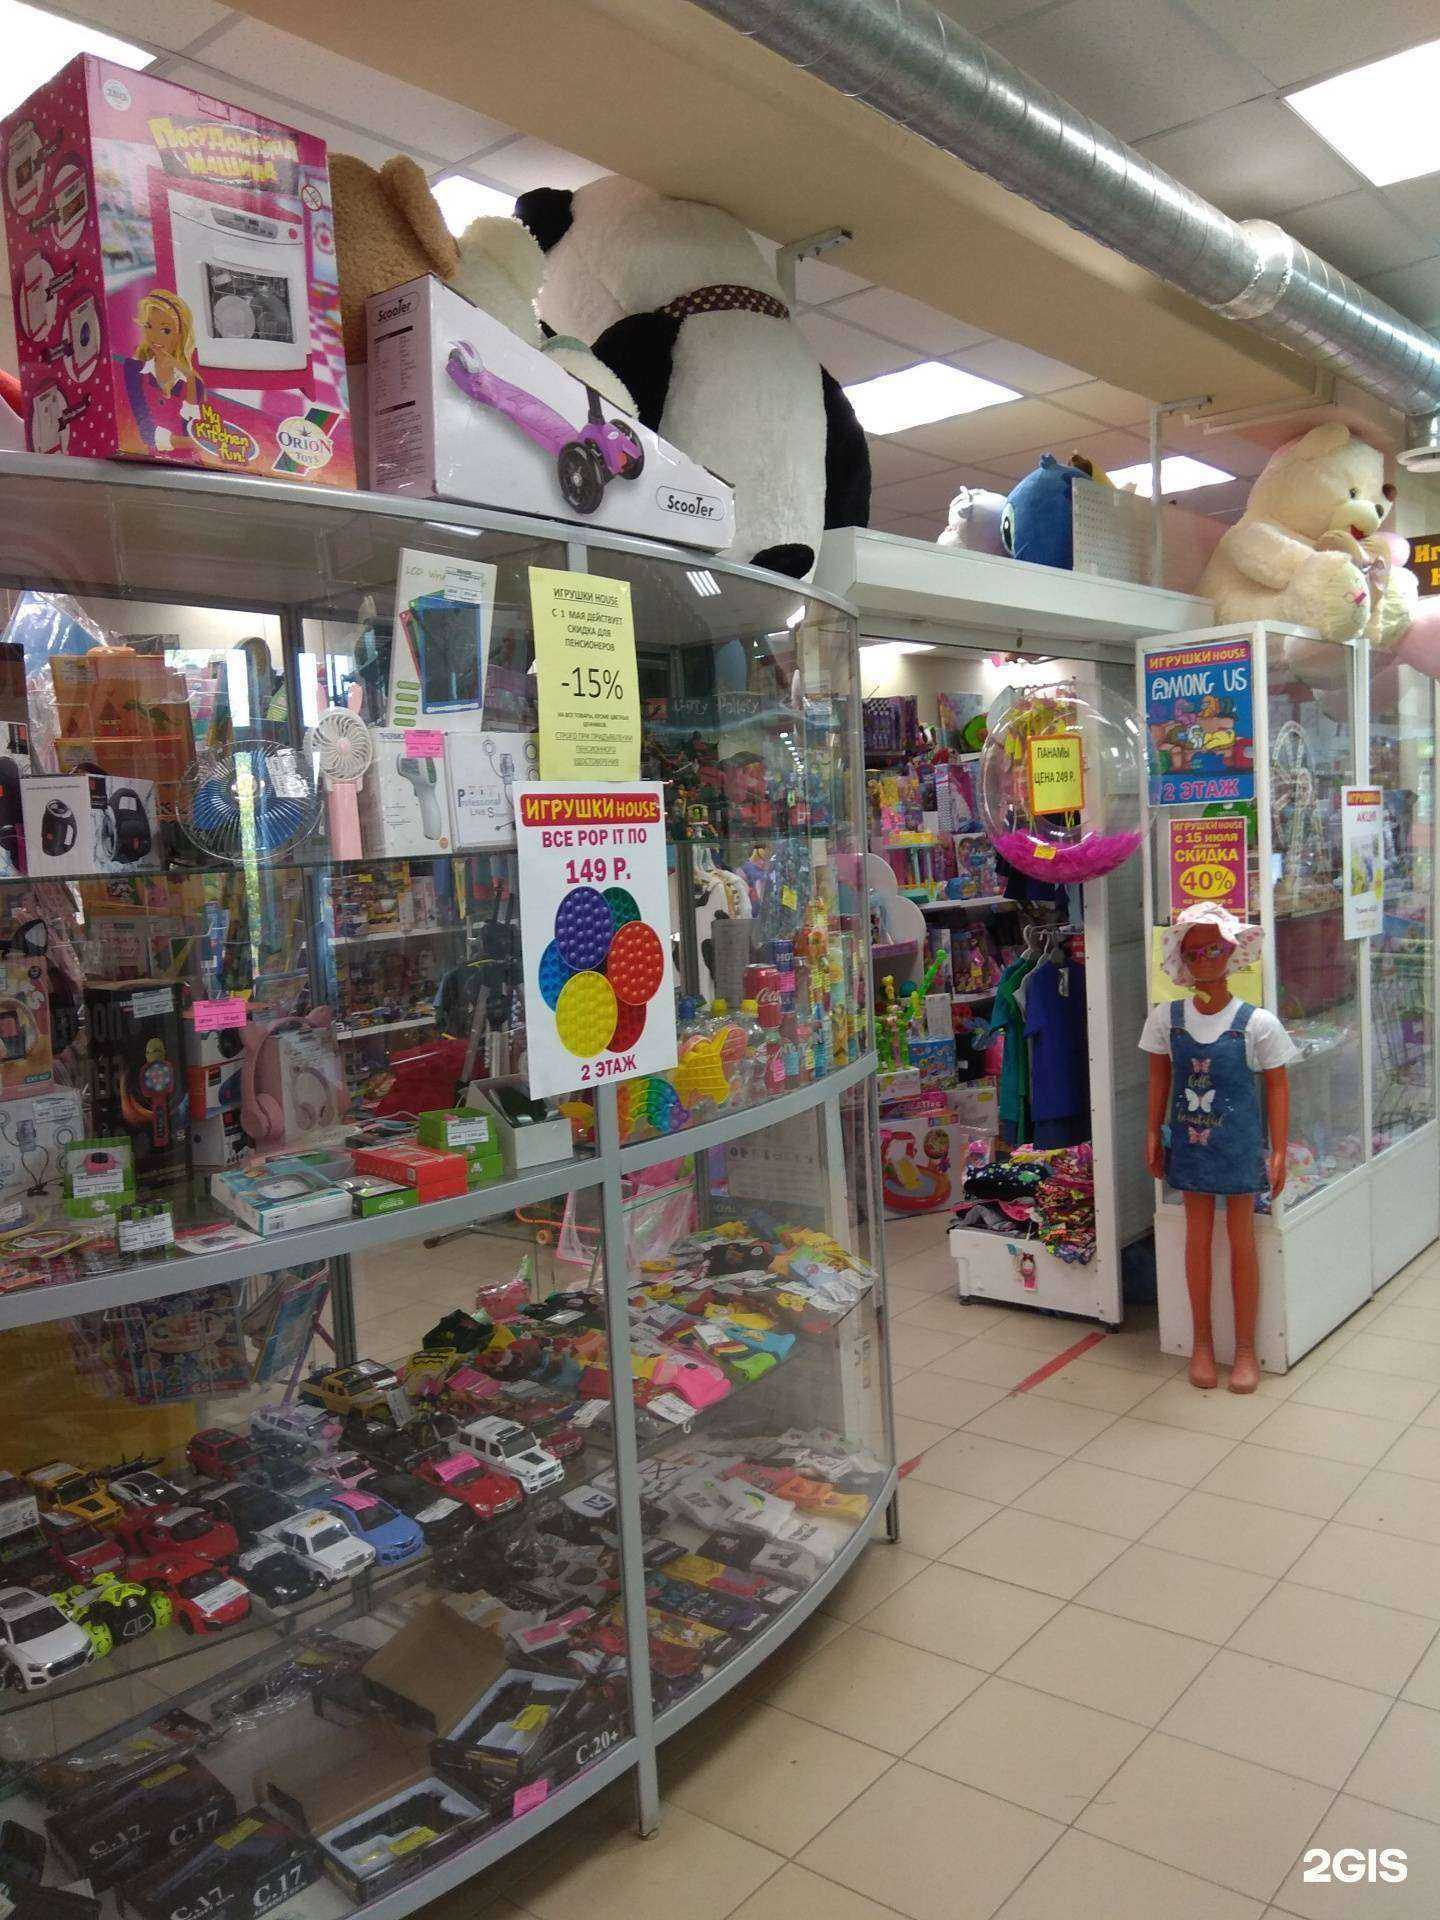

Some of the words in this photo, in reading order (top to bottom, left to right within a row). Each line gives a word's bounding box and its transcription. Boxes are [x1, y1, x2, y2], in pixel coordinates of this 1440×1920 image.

[295, 452, 319, 464] TOYS
[553, 587, 594, 603] ИГРУШКИ
[595, 592, 618, 605] HOUSE
[568, 610, 586, 621] МАЯ
[587, 611, 623, 626] ДЕЙСТВУЕТ
[567, 624, 596, 637] СКИДКА
[597, 626, 611, 638] ДЛЯ
[565, 637, 615, 652] ПЕНСИОНЕРОВ
[1149, 649, 1212, 669] ИГРУШКИ
[1212, 647, 1246, 662] HOUSE
[561, 667, 624, 701] -15%
[1151, 671, 1215, 701] AMONG
[1223, 667, 1248, 692] US
[1037, 746, 1070, 758] ПАНАМЫ
[1034, 772, 1055, 786] ЦЕНА
[1163, 784, 1175, 800] 2
[1180, 778, 1239, 798] ЭТАЖ
[526, 796, 615, 821] ИГРУШКИ
[616, 799, 657, 819] HOUSE
[1172, 822, 1217, 831] ИГРУШКИ
[542, 829, 573, 848] ВСЕ
[578, 828, 608, 847] POP
[613, 828, 625, 845] IT
[627, 827, 647, 845] ПО
[1185, 832, 1202, 843] 15
[1174, 848, 1239, 864] СКИДКА
[566, 858, 607, 884] 149
[613, 857, 632, 881] Р.
[1182, 870, 1233, 890] 40%
[581, 1063, 590, 1081] 2
[595, 1054, 637, 1078] ЭТАЖ
[575, 1728, 618, 1765] C.20+
[169, 1809, 220, 1847] C.17
[252, 1863, 303, 1908] C.17
